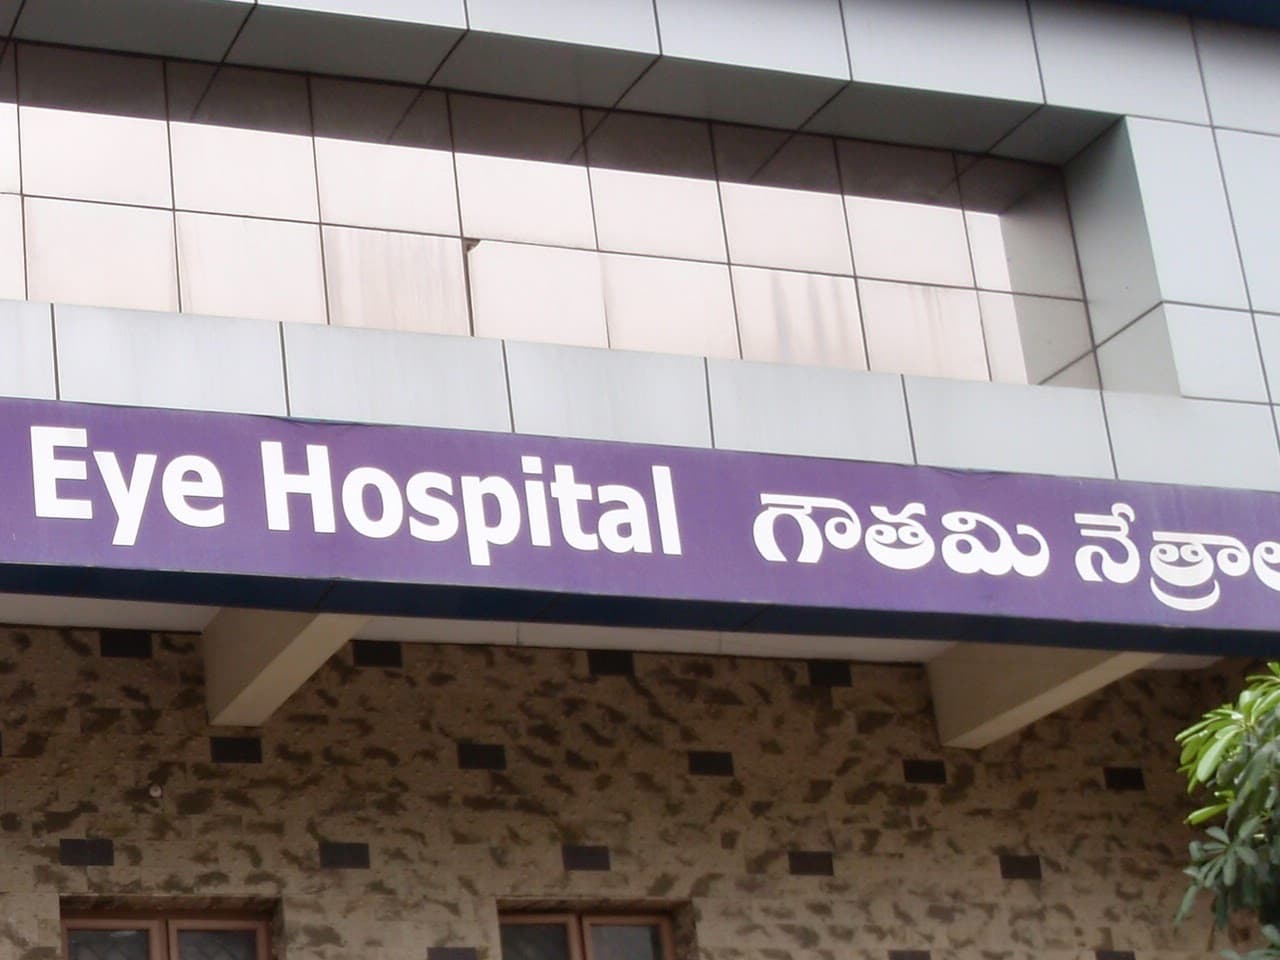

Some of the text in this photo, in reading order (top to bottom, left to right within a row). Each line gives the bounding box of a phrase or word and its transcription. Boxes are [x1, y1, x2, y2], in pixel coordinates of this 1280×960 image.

[30, 426, 225, 546] Eye
[261, 441, 681, 566] Hospital
[753, 493, 1049, 577] గౌతమి
